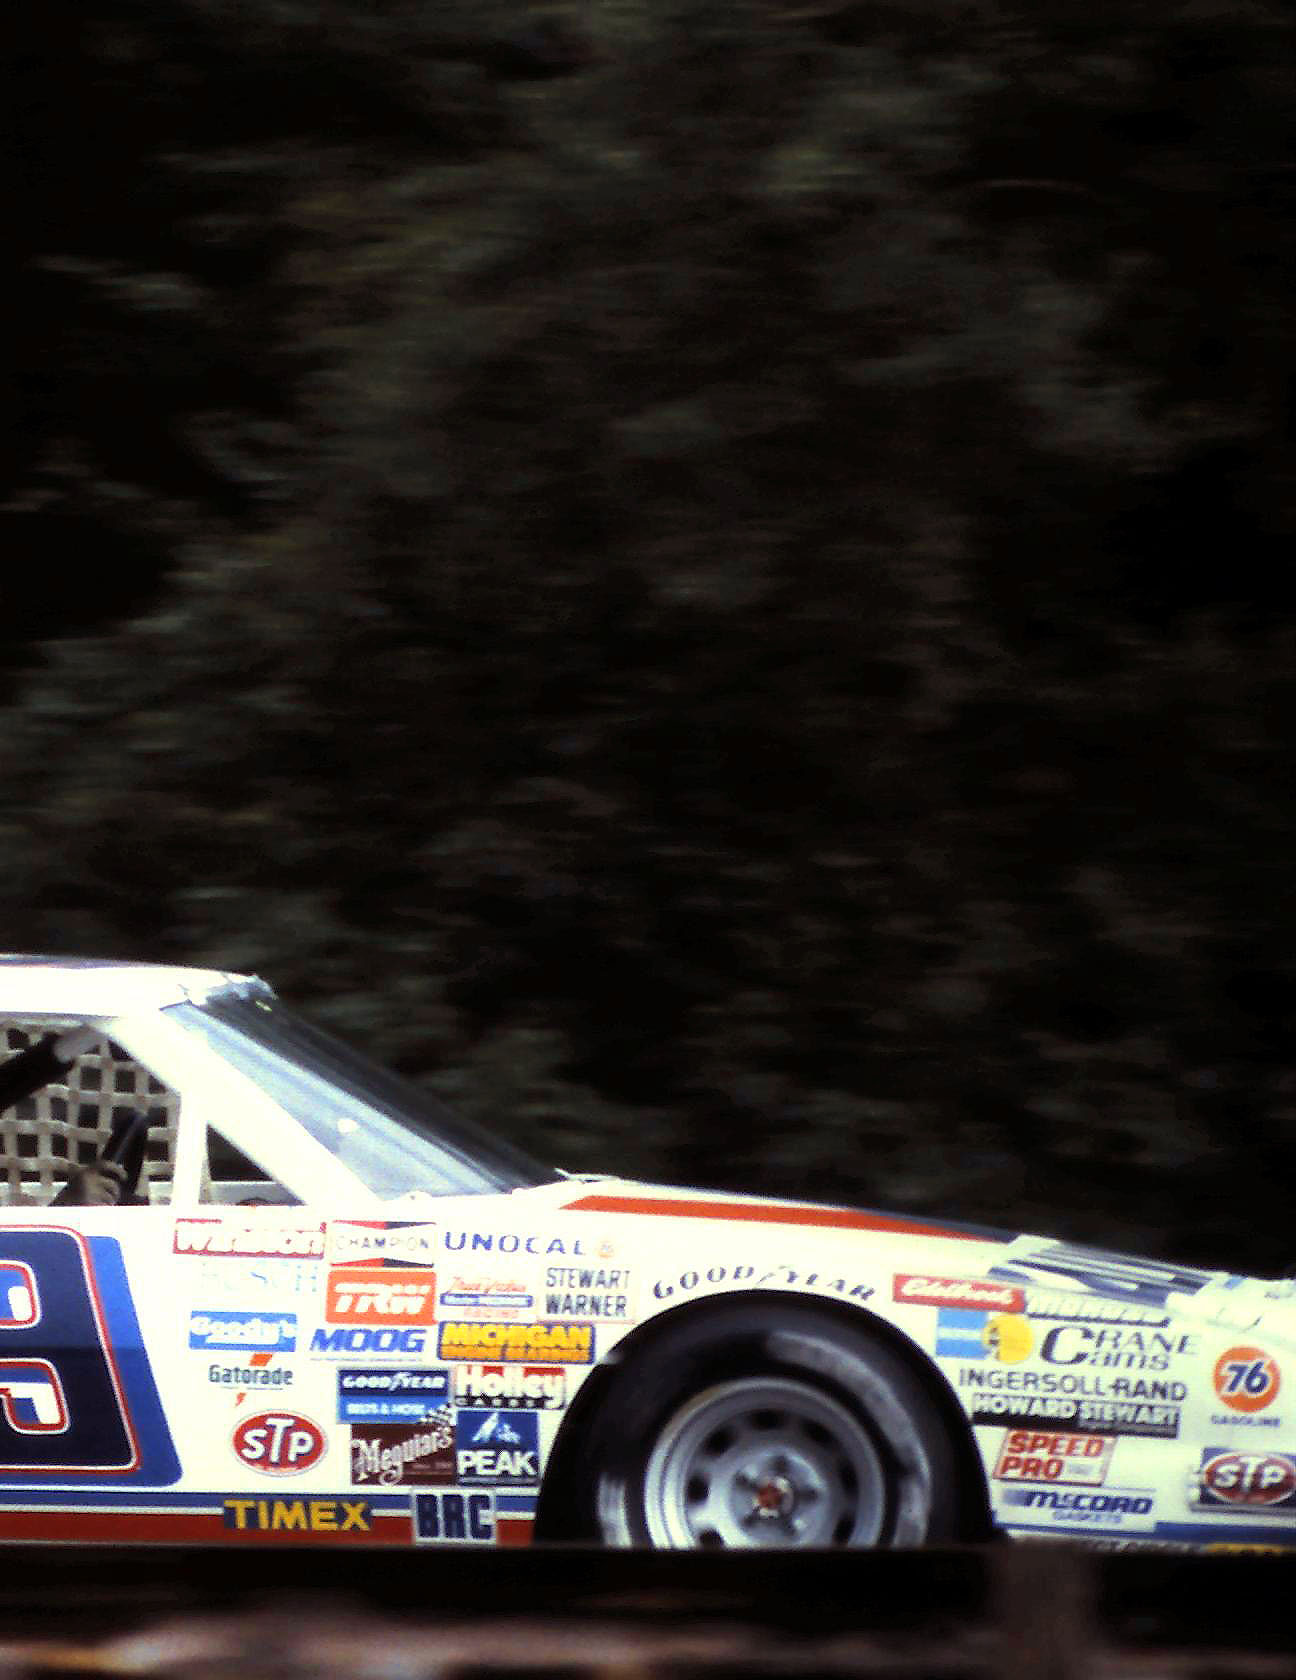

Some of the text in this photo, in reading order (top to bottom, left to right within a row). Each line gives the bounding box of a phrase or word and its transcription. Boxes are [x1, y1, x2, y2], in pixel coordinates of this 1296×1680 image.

[445, 1232, 585, 1255] UNOCAL
[546, 1268, 630, 1288] STEWART
[334, 1283, 431, 1314] TRW
[545, 1294, 627, 1317] WARNER
[309, 1328, 427, 1352] MOOG
[208, 1364, 294, 1386] Gatorade
[1227, 1361, 1269, 1394] 76
[241, 1418, 314, 1463] STP
[1007, 1432, 1104, 1457] SPEED
[457, 1451, 537, 1476] PEAK
[1000, 1456, 1064, 1479] PRO
[1214, 1456, 1287, 1492] STP
[224, 1500, 371, 1531] TIMEX
